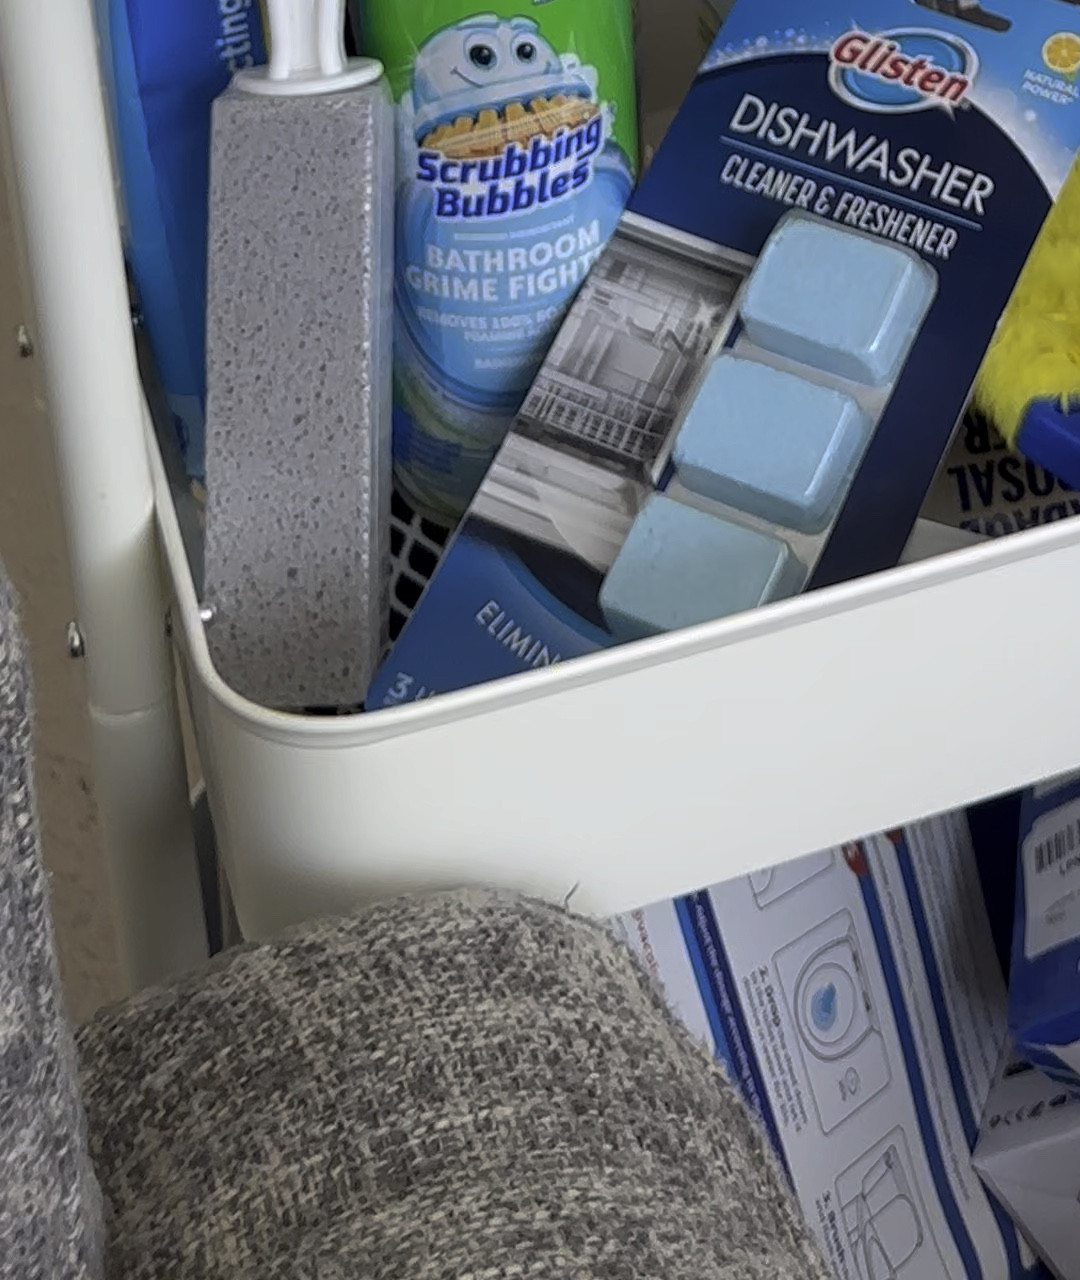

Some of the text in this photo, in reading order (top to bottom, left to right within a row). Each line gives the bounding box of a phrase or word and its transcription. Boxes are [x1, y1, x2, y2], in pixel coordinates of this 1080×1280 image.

[831, 28, 970, 103] Glisten
[1022, 68, 1080, 99] NATURAL
[415, 114, 603, 183] Scrubbing
[728, 91, 997, 217] DISHWASHER
[435, 159, 591, 219] Bubbles
[718, 153, 959, 261] CLEANER & FRESHENER
[404, 250, 596, 302] GRIME FIGHT
[424, 219, 600, 274] BATHROOM
[948, 454, 1062, 513] OSAL
[475, 599, 562, 674] ELIMIN
